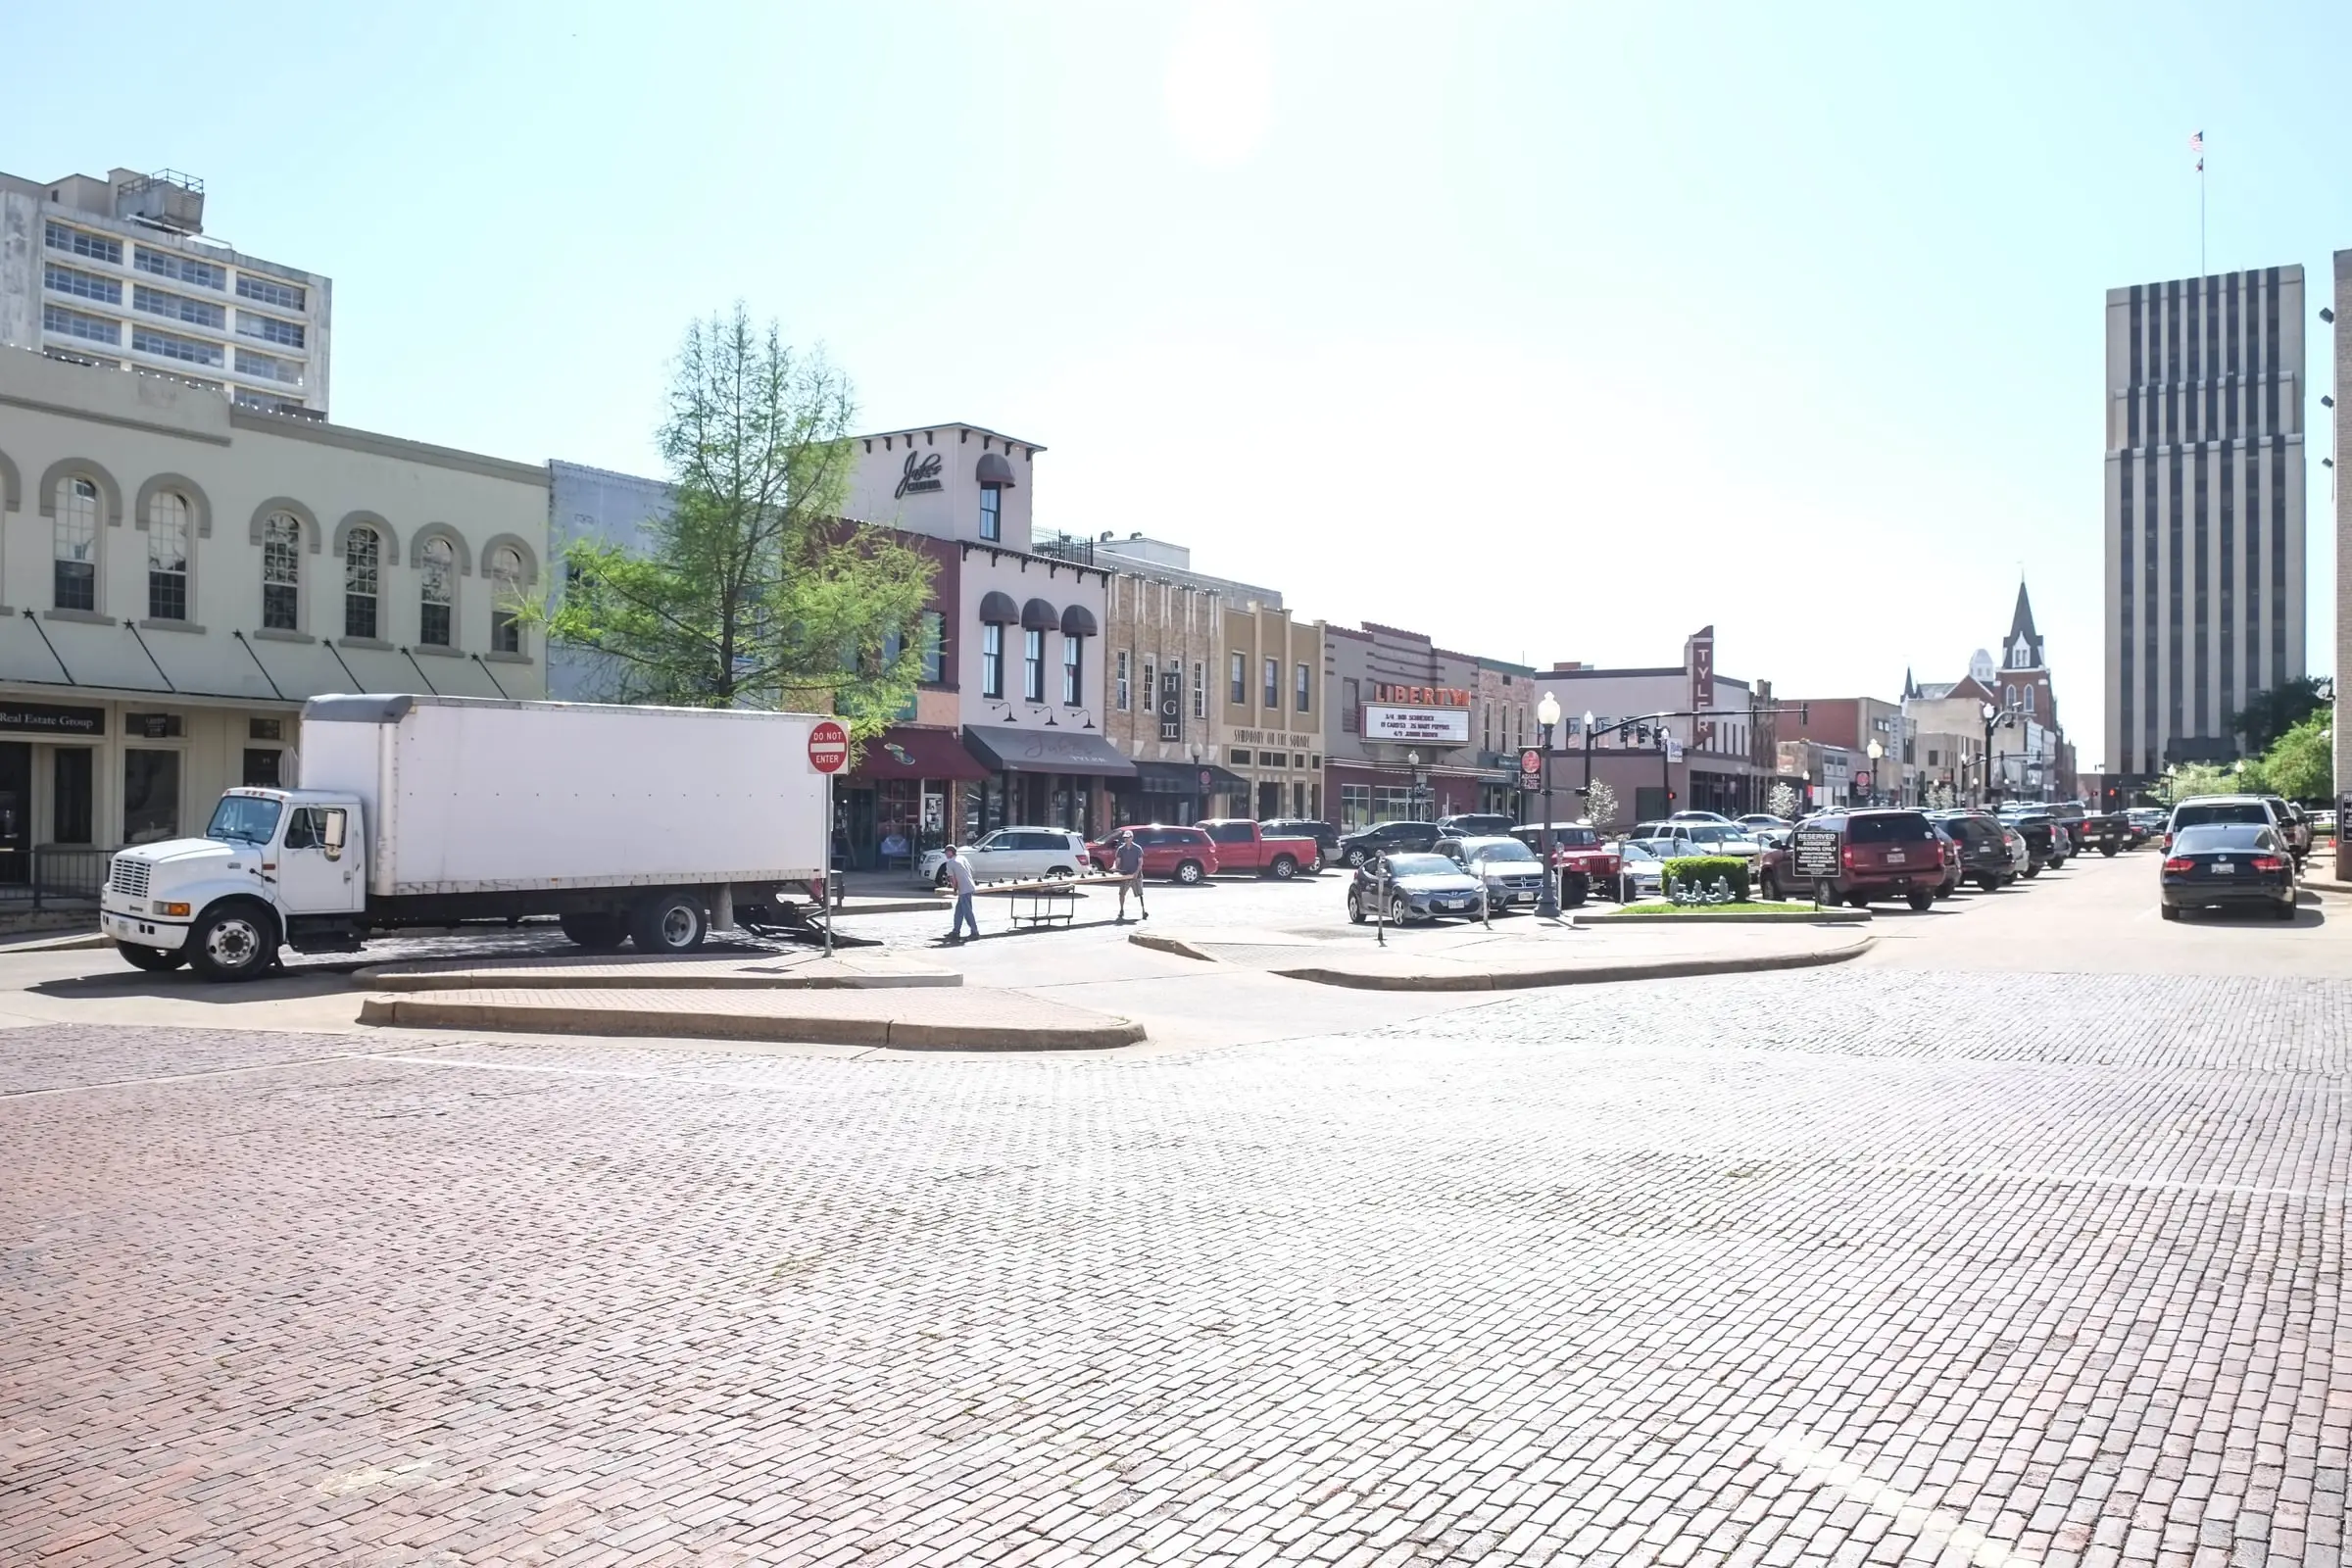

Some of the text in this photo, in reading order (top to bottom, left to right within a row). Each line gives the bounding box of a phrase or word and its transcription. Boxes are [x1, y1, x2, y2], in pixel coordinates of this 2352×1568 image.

[1374, 685, 1462, 706] LIBERTY
[0, 711, 94, 729] Real Estate Group
[813, 731, 842, 741] DO NOT
[1234, 729, 1310, 749] SYMPHONY ON THE SQUARE
[815, 755, 839, 763] ENTER
